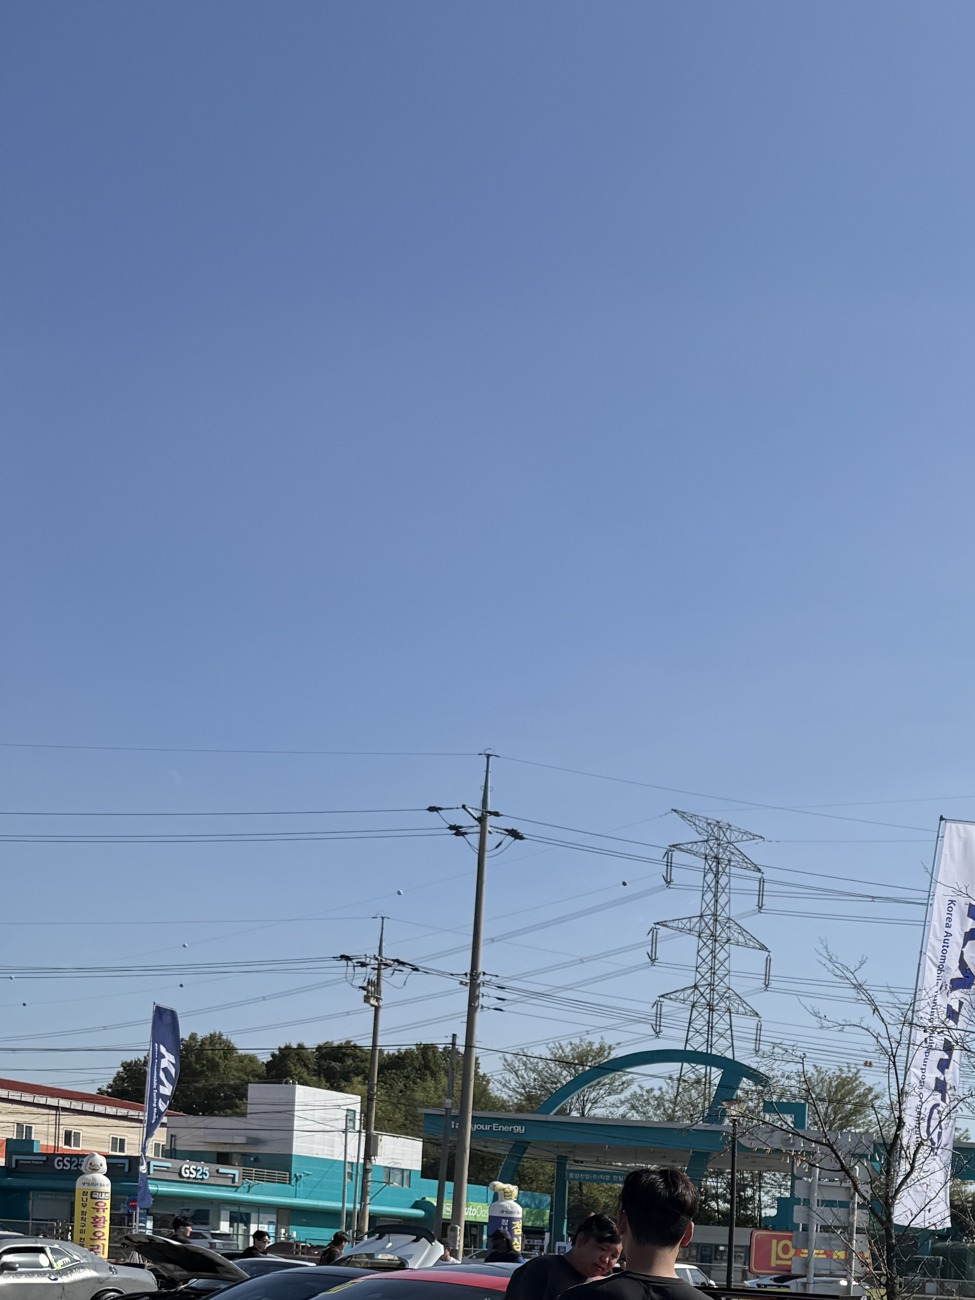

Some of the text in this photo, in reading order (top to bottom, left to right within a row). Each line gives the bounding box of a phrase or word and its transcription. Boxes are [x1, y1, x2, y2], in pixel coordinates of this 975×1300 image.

[944, 899, 957, 929] Korea
[493, 1123, 525, 1134] Energy
[181, 1164, 210, 1179] GS25
